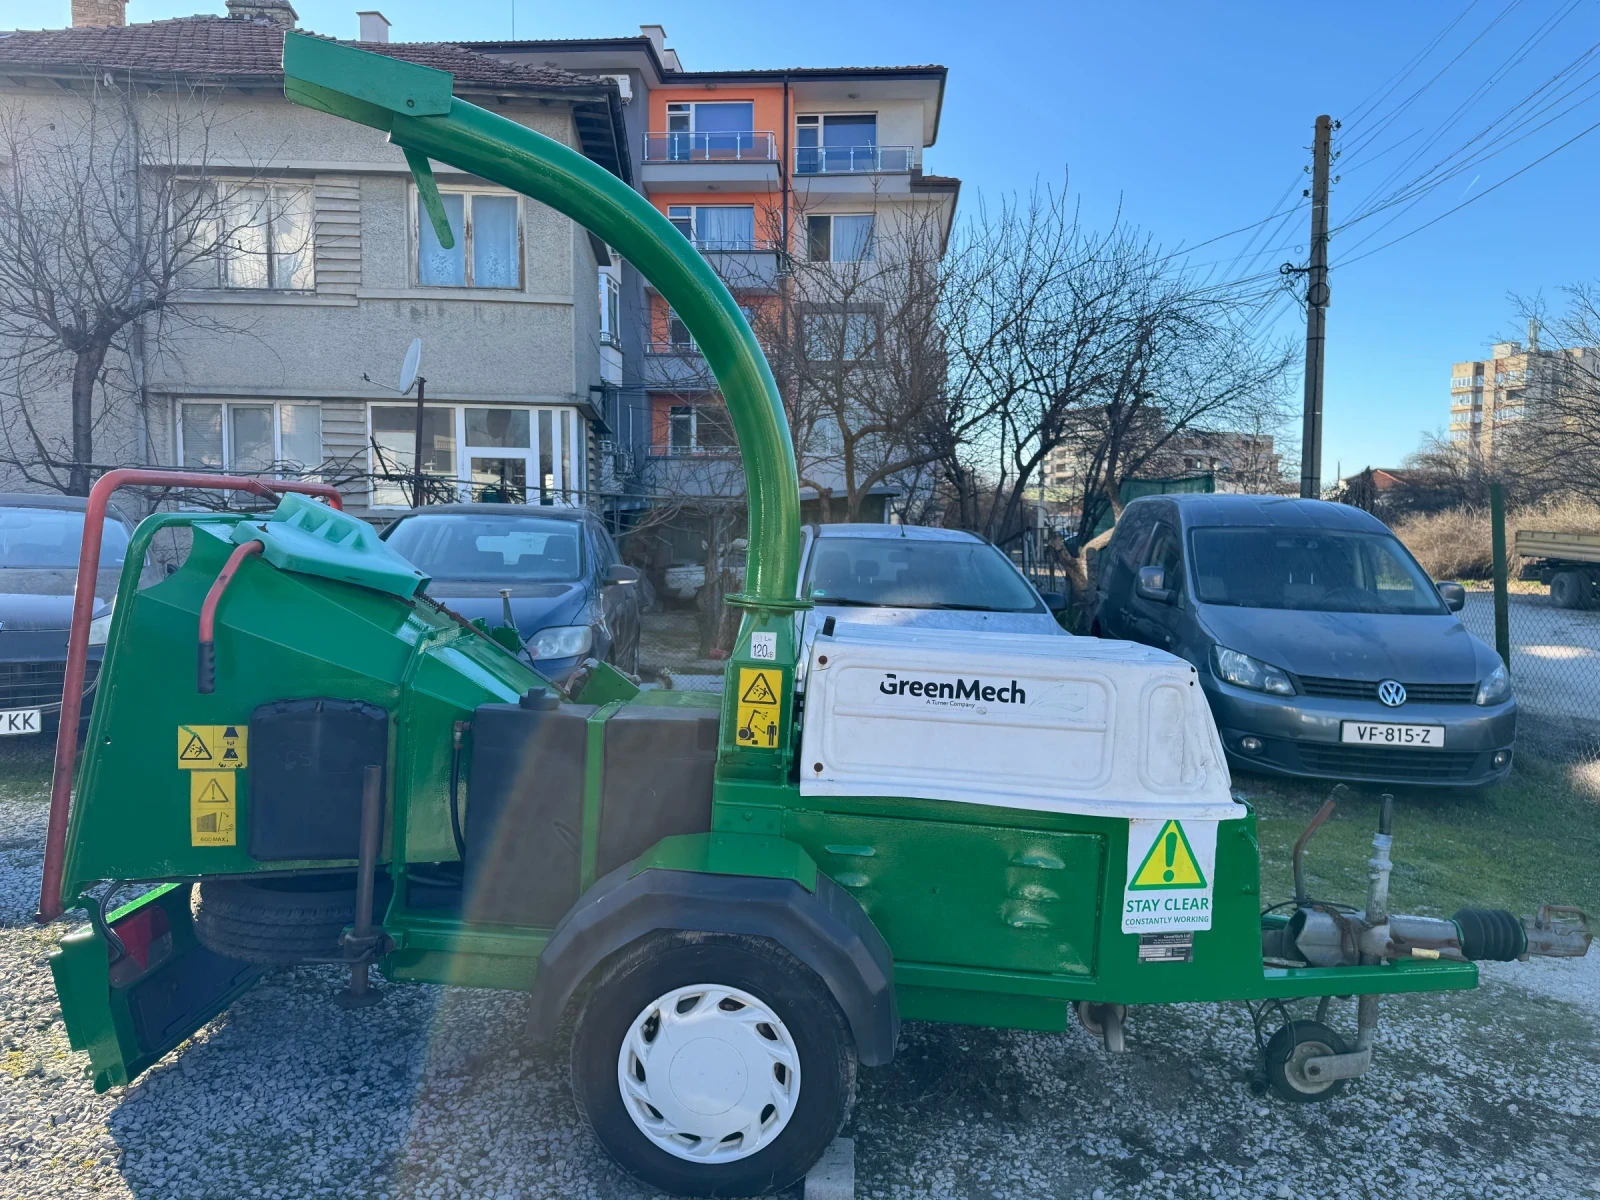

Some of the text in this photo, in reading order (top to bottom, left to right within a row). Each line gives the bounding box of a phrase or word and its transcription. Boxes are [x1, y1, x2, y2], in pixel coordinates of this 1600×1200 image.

[753, 643, 768, 658] 120
[880, 673, 1026, 704] GreenMech
[949, 700, 976, 709] Company
[1357, 726, 1431, 744] VF-815-Z
[1126, 898, 1209, 913] STAY CLEAR
[1125, 917, 1172, 926] CONSTANTLY
